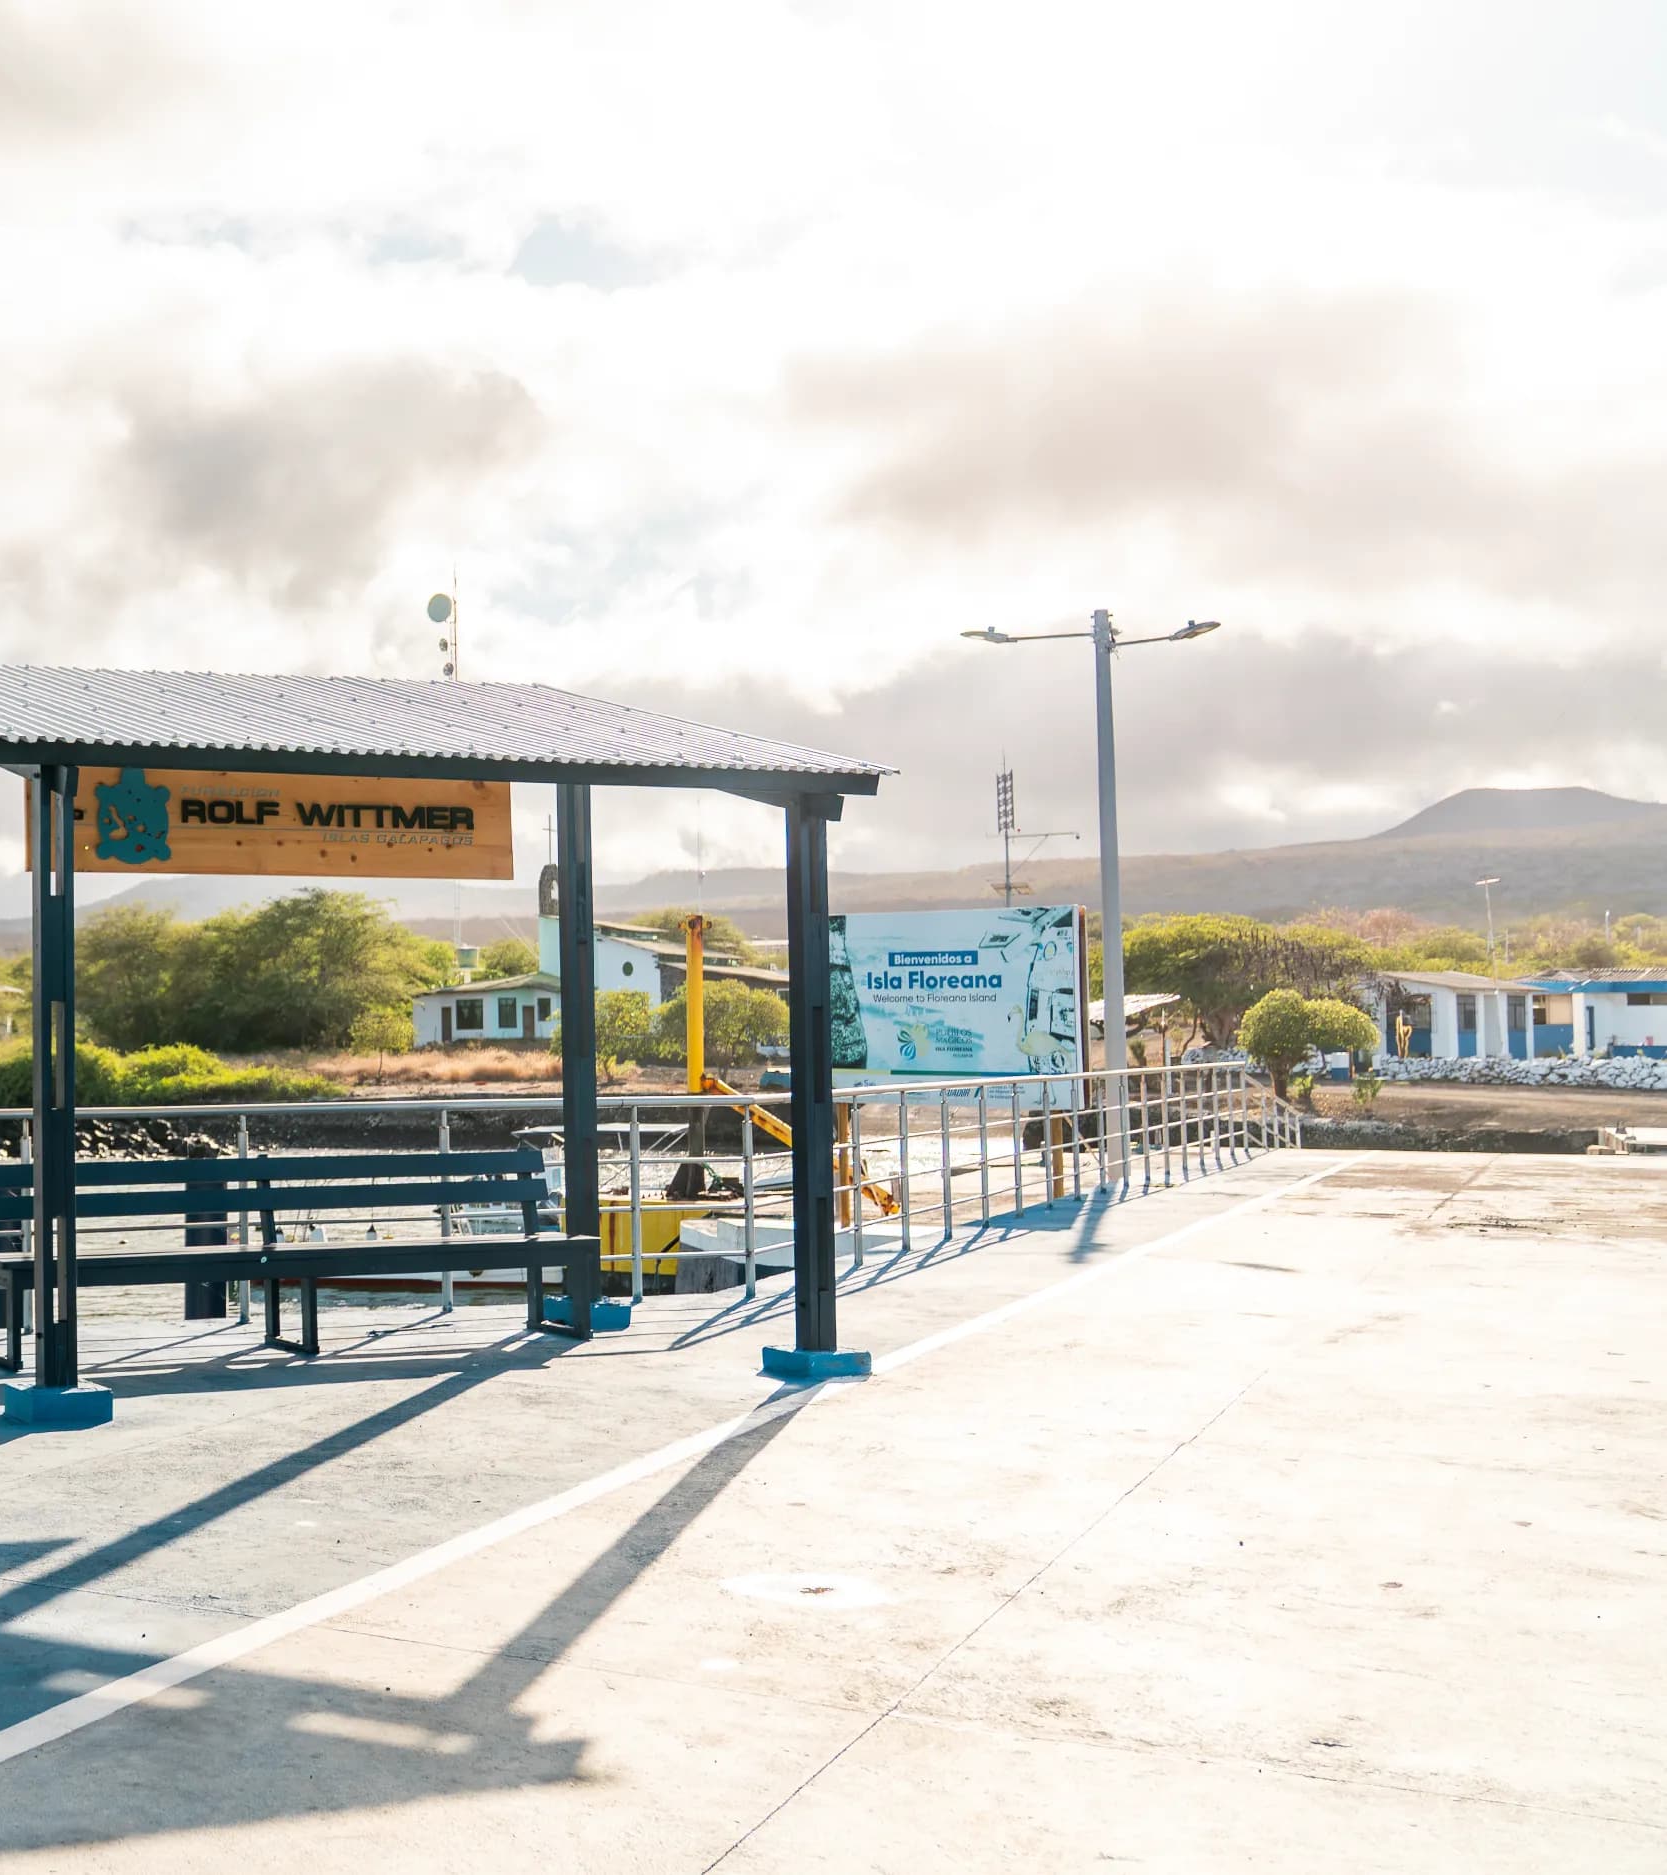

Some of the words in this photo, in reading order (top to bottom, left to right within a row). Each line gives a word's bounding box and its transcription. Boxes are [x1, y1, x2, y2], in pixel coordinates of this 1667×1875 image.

[180, 800, 280, 824] ROLF
[295, 802, 475, 830] WITTMER
[323, 832, 369, 843] ISLAS
[893, 954, 961, 966] Bienvenidos
[964, 956, 972, 964] a
[867, 972, 902, 990] Isla
[908, 971, 1002, 990] Floreana
[873, 995, 914, 1003] Welcome
[916, 995, 925, 1003] to
[927, 994, 967, 1003] Floreana
[969, 993, 997, 1002] Island
